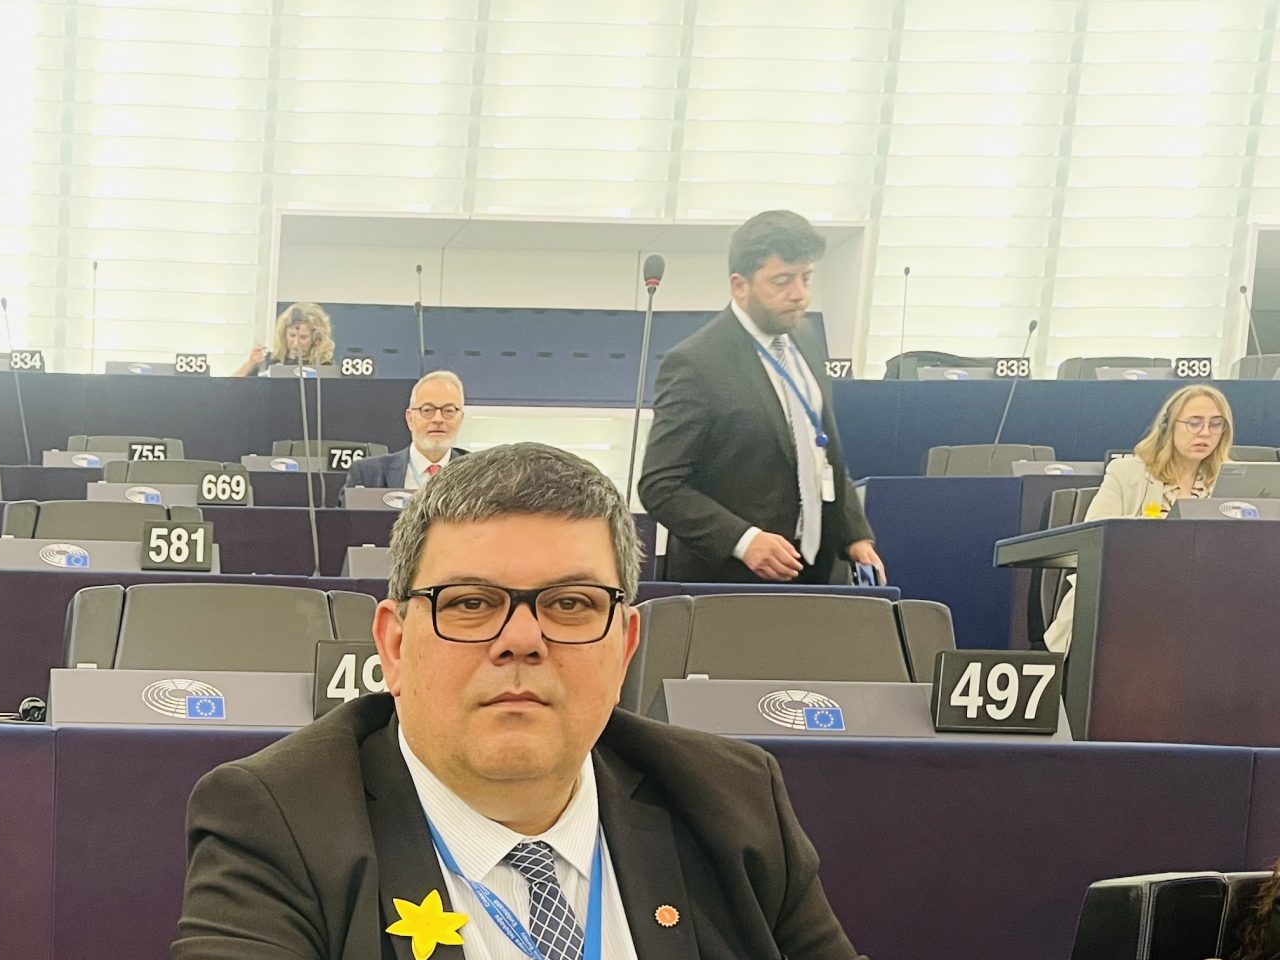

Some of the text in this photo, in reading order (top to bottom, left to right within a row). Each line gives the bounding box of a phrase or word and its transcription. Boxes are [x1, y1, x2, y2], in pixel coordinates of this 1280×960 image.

[11, 351, 41, 369] 834
[176, 355, 207, 373] 835
[342, 359, 373, 375] 836
[996, 360, 1029, 376] 838
[1177, 360, 1210, 377] 839
[131, 445, 165, 460] 755
[202, 475, 246, 501] 669
[149, 528, 205, 562] 581
[327, 654, 391, 703] 49
[951, 662, 1056, 719] 497
